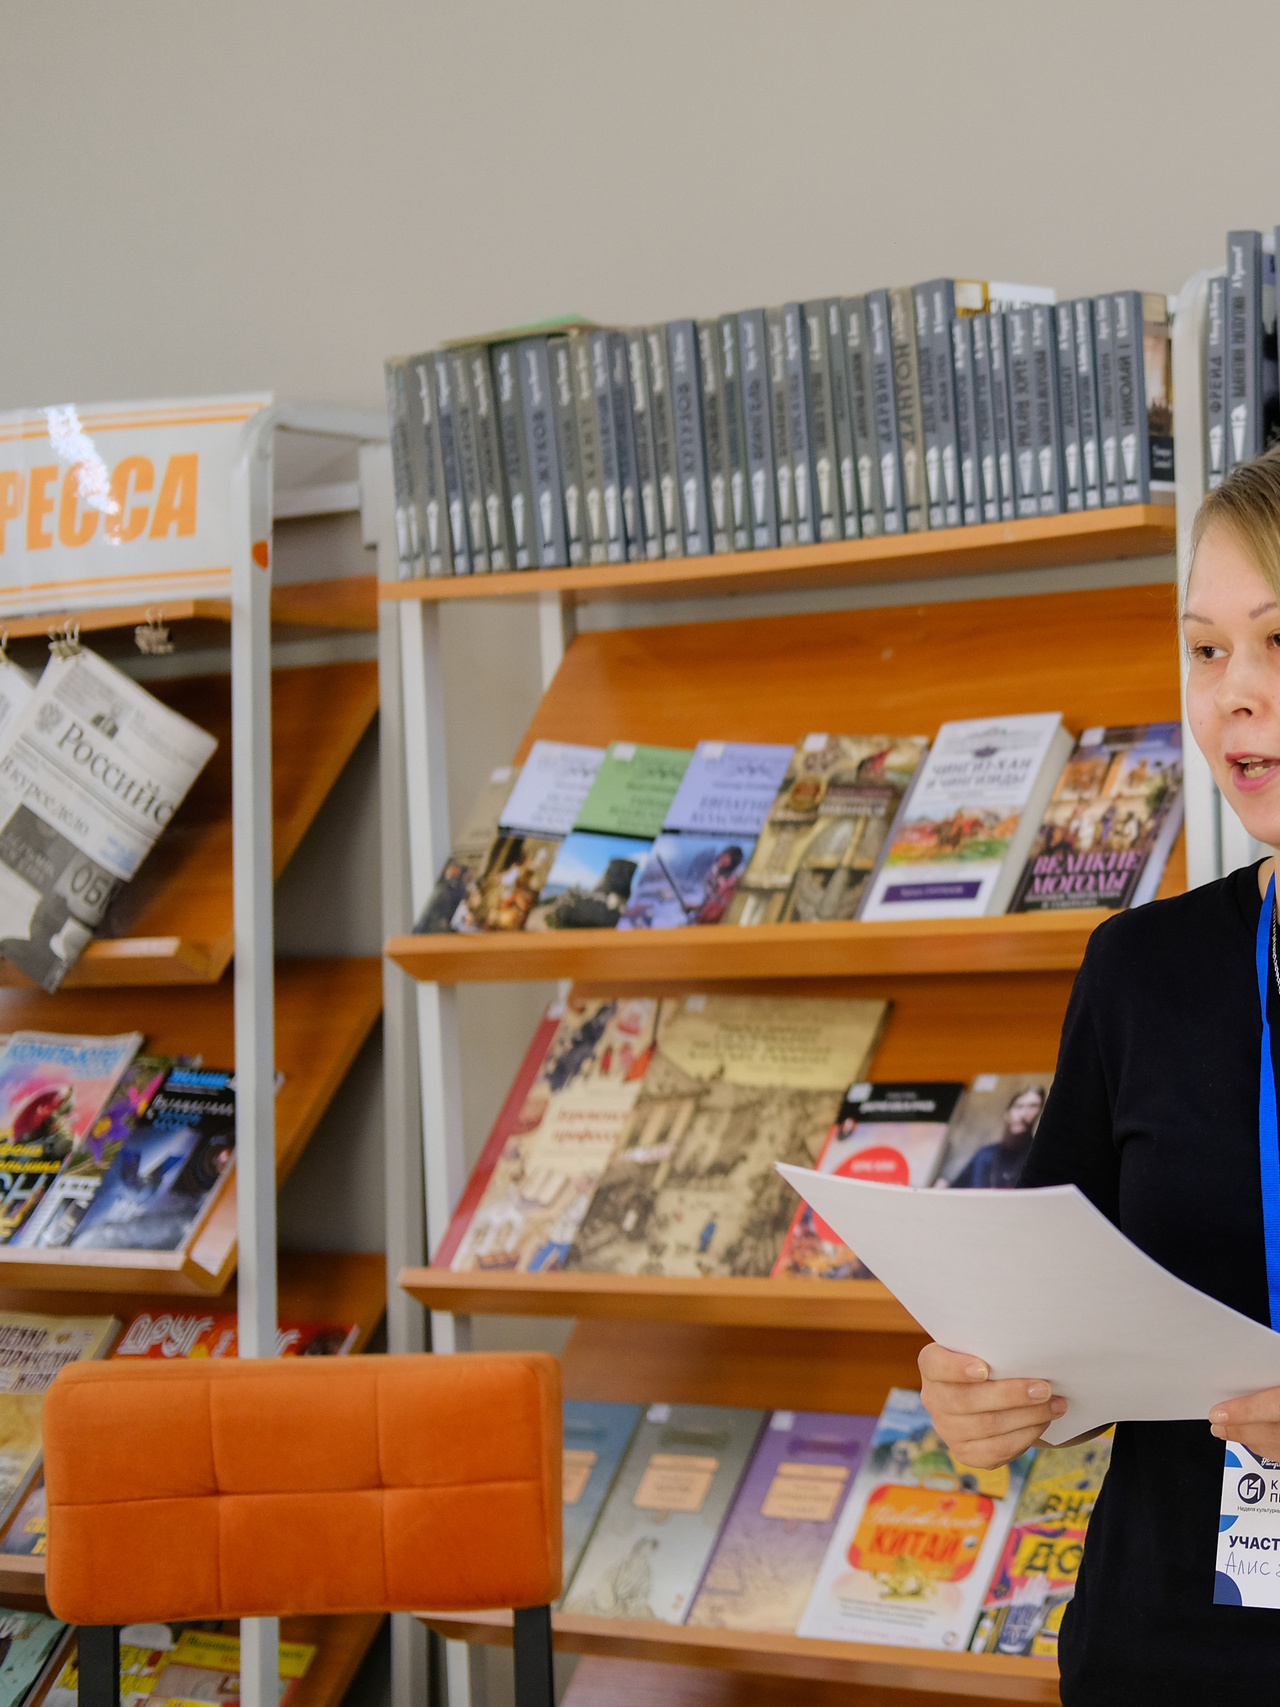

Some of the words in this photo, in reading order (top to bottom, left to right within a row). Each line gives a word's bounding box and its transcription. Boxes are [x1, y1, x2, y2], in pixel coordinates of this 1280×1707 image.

[895, 343, 915, 445] ДАНТОН
[1119, 356, 1134, 426] НИКОЛАЙ
[1210, 355, 1222, 413] ФРЕЙД
